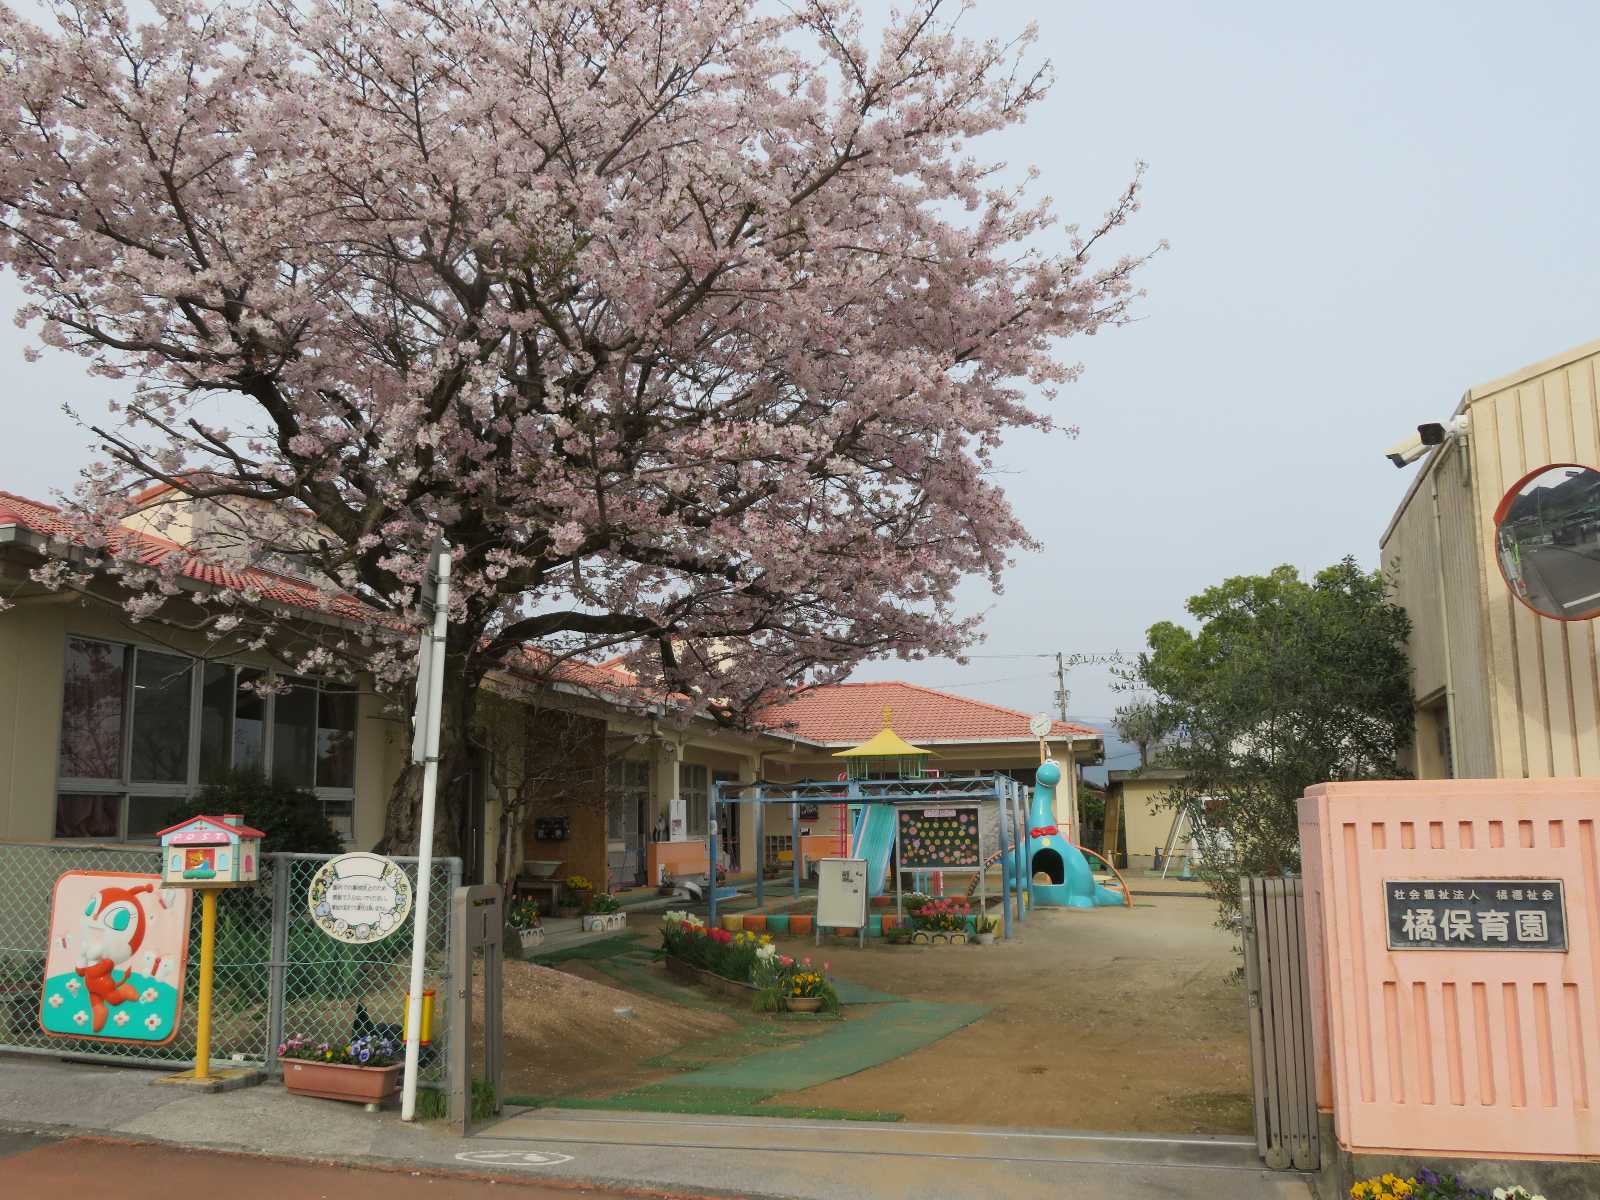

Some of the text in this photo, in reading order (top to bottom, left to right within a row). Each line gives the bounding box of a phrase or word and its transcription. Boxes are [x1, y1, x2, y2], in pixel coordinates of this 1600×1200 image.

[1394, 889, 1481, 901] 社会福祉法人
[1402, 908, 1549, 942] 橘保育園
